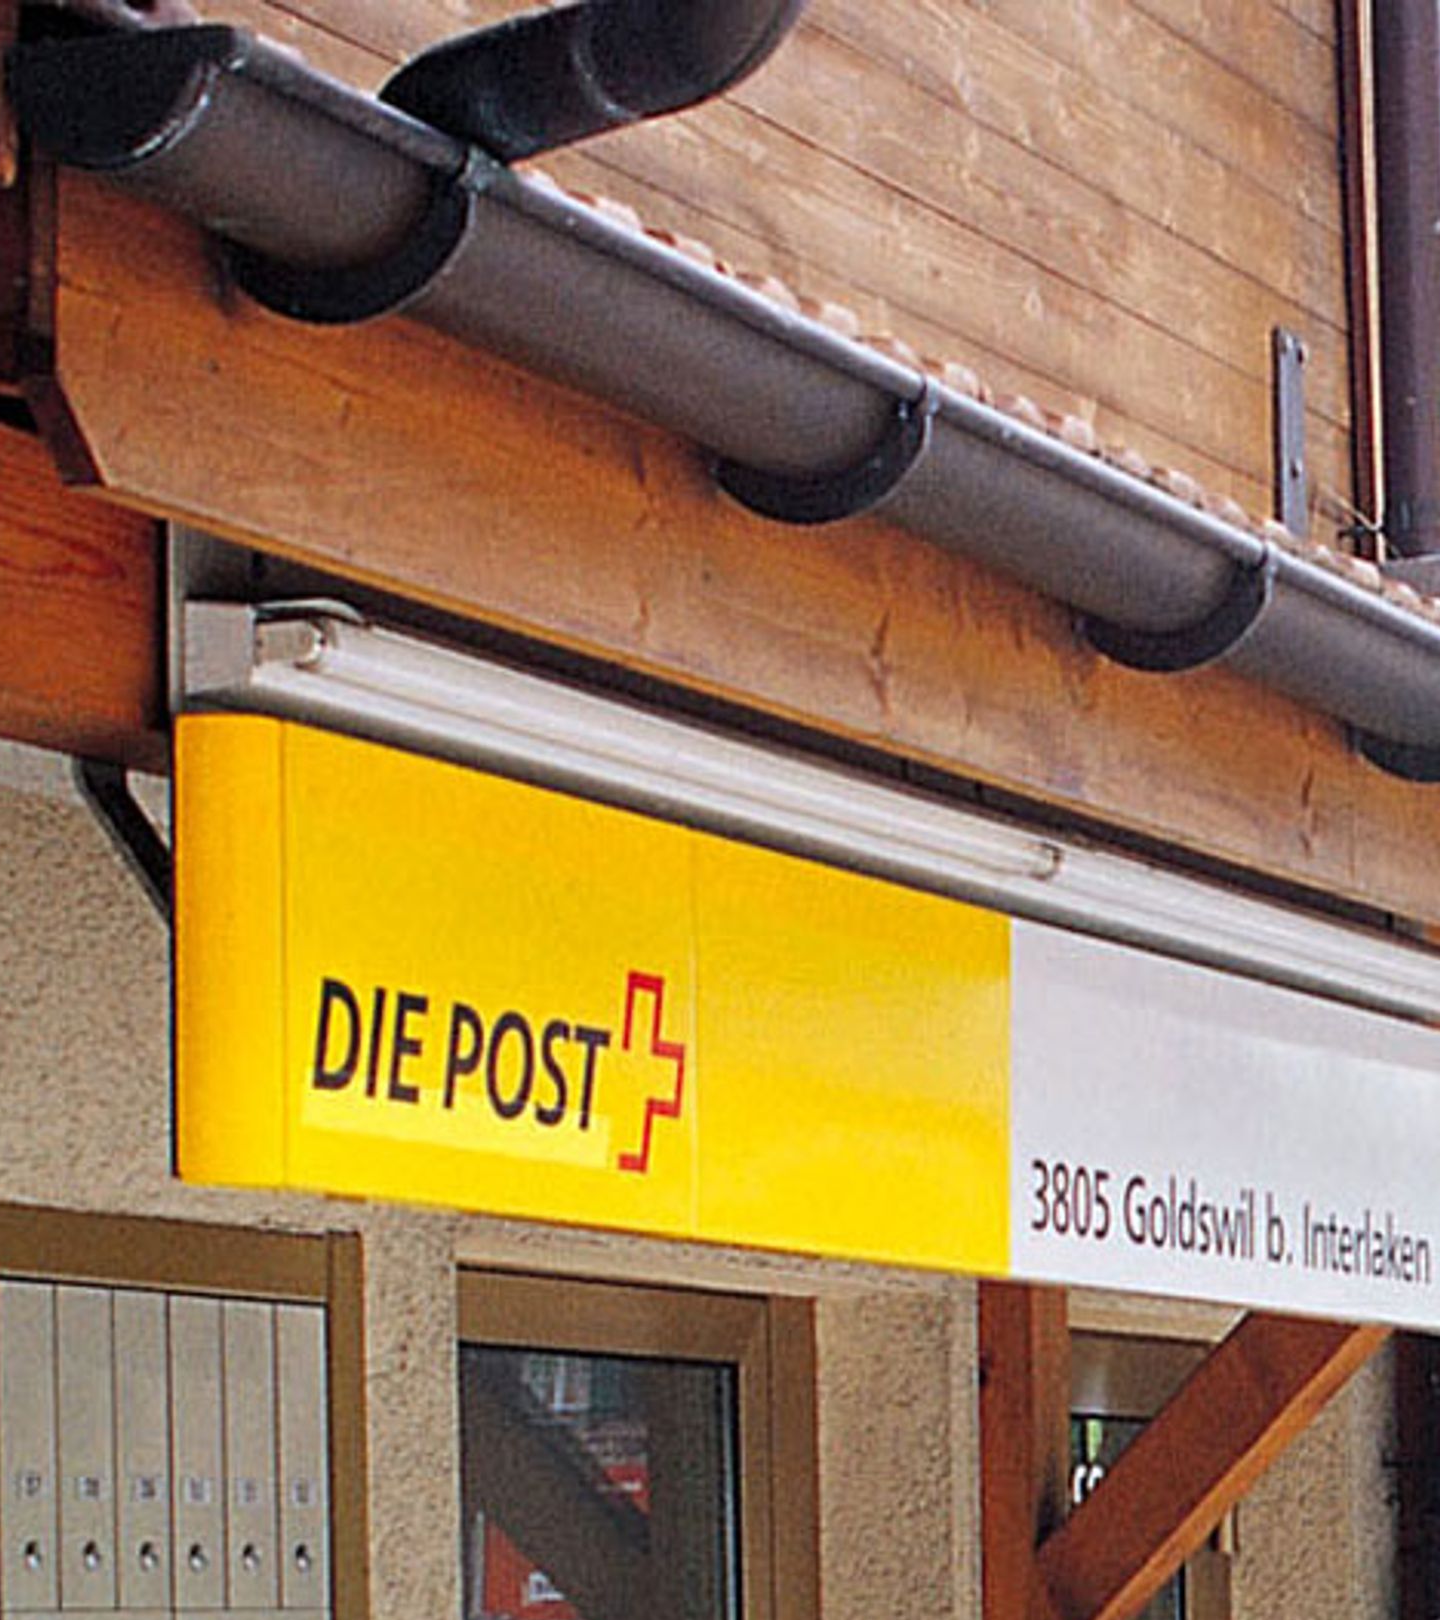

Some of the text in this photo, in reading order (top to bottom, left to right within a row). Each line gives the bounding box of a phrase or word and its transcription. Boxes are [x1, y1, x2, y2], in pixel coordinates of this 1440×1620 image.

[313, 977, 611, 1130] DIE POST
[1030, 1159, 1432, 1284] 3805 Goldswil b. Interlaken
